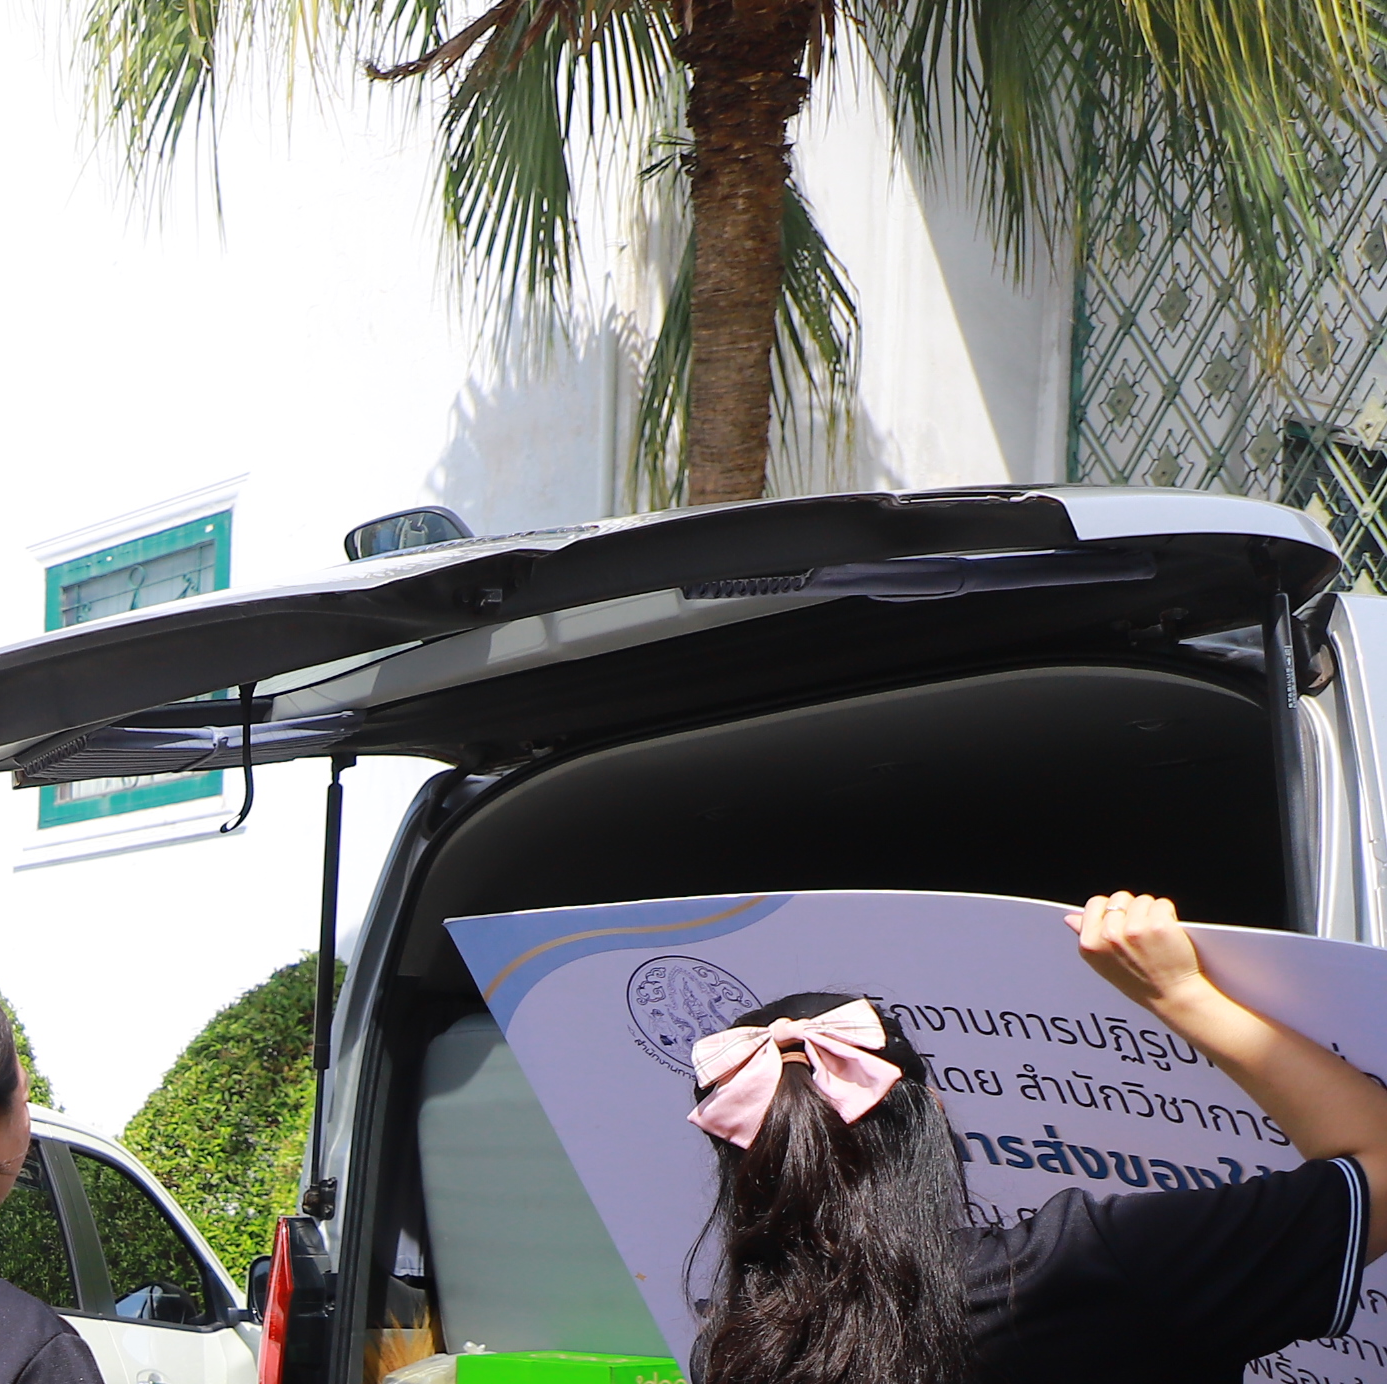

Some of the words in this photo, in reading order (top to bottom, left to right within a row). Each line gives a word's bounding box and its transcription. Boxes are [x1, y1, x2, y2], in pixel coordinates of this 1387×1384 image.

[863, 993, 1213, 1072] ักงานการปฏิรูป
[1016, 1064, 1291, 1147] สำนักวิชาการ
